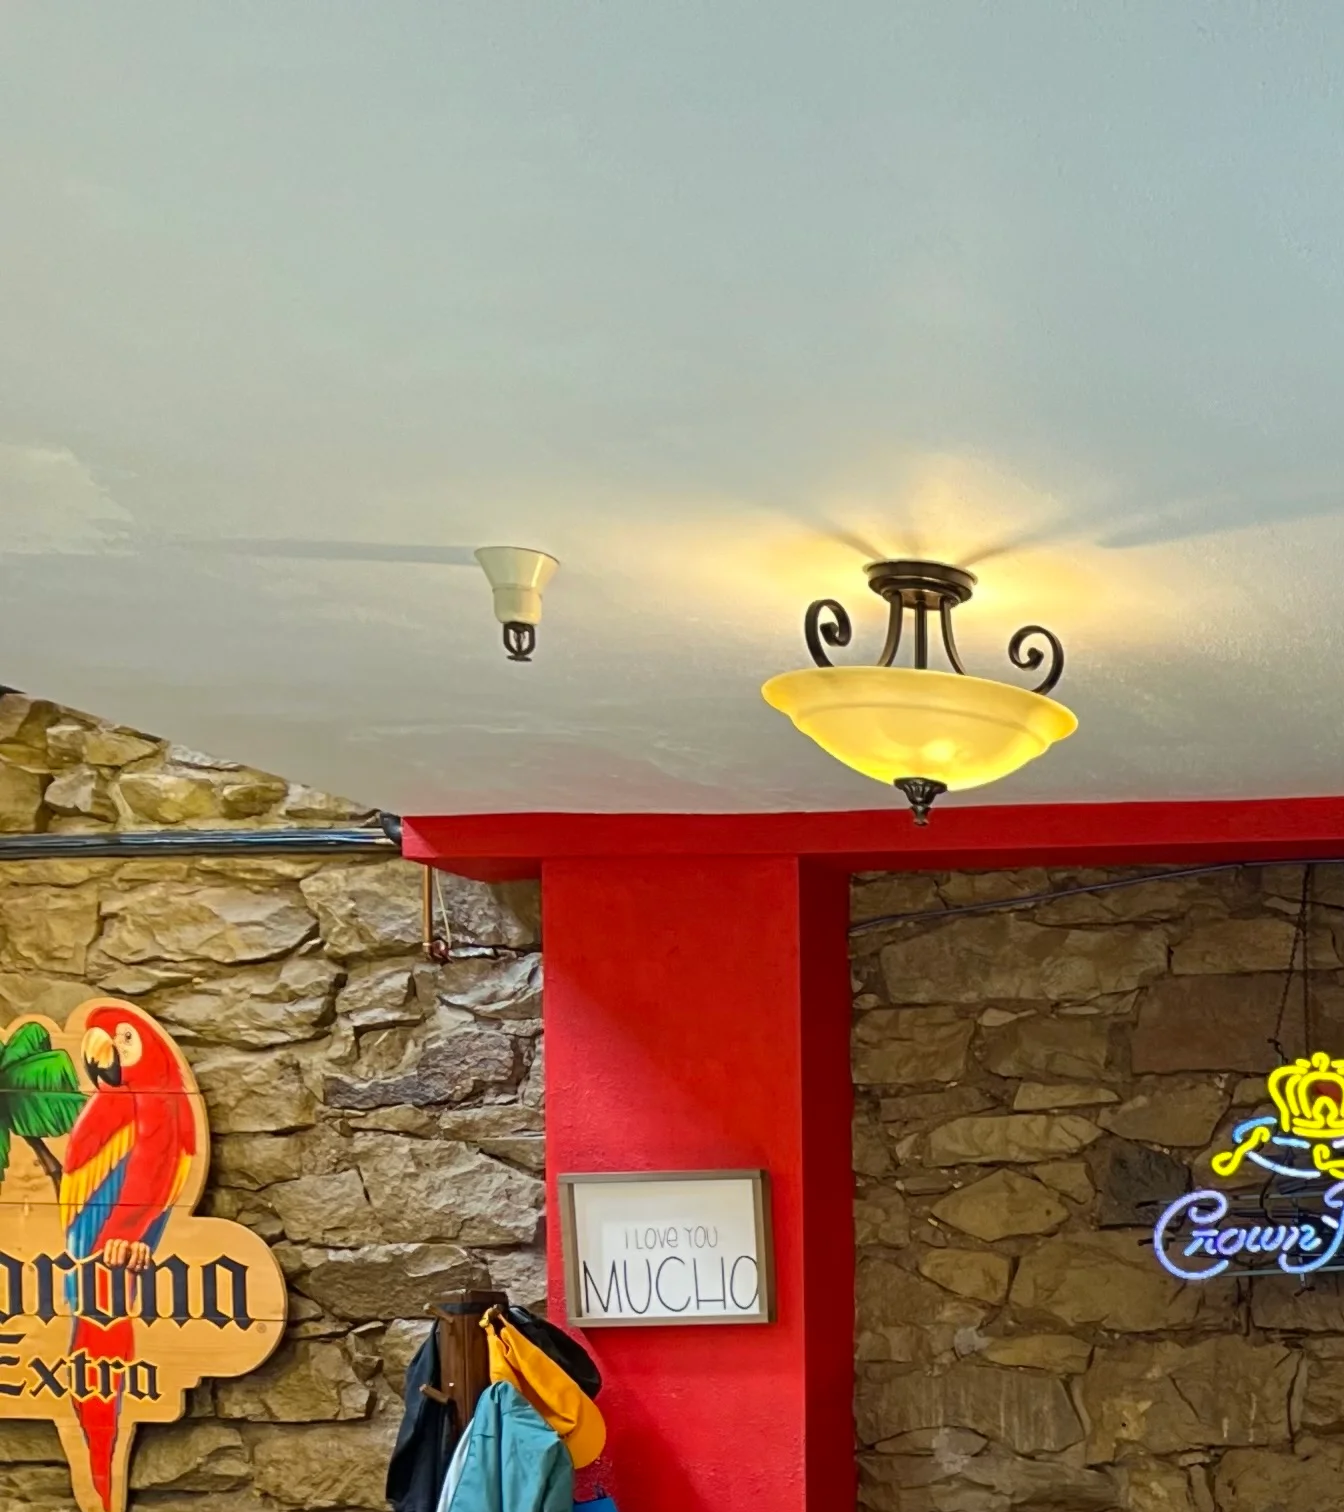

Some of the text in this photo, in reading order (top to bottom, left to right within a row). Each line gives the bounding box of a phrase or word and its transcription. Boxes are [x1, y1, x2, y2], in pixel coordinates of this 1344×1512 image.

[684, 1225, 718, 1248] YOU
[1153, 1189, 1323, 1280] Crown
[582, 1254, 759, 1315] MUCHO
